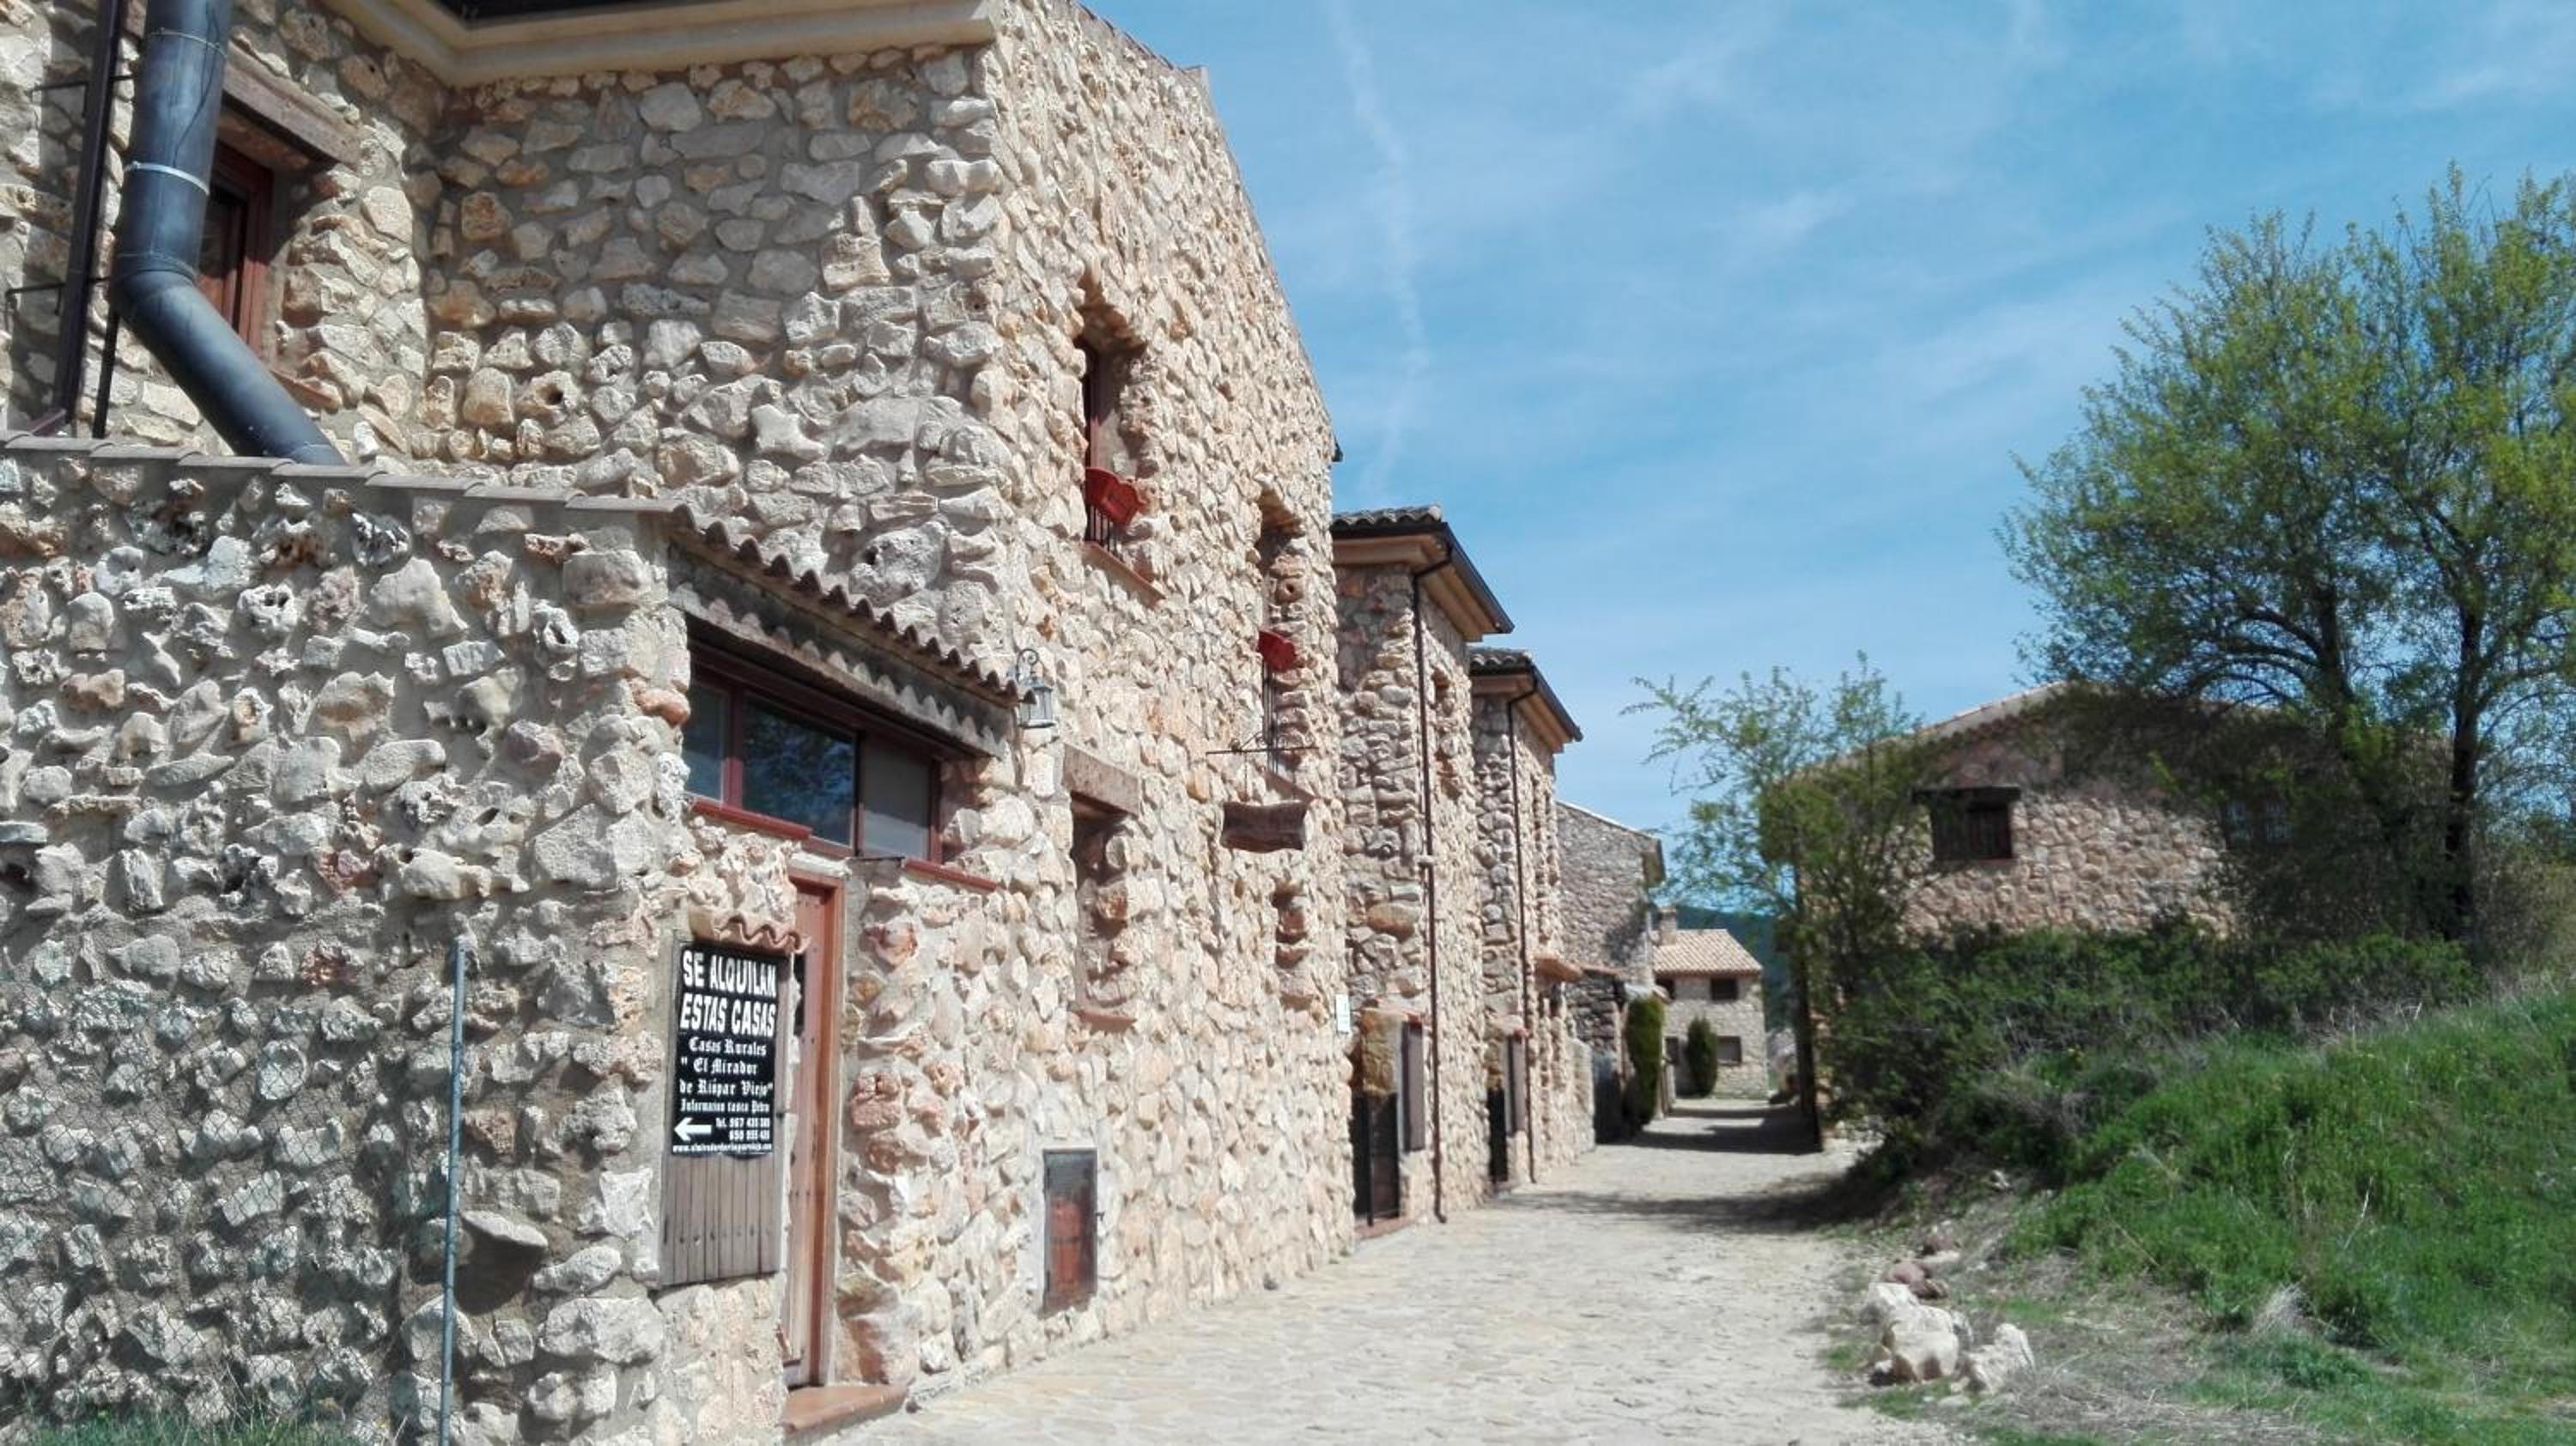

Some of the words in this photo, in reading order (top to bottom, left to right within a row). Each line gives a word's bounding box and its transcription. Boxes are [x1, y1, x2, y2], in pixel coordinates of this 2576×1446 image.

[683, 950, 704, 987] SE
[710, 954, 776, 999] ALQUILAN
[680, 992, 727, 1033] ESTAS
[732, 999, 776, 1038] CASAS
[689, 1036, 721, 1054] Casas
[724, 1038, 766, 1056] Rurales
[693, 1057, 708, 1072] El
[711, 1058, 756, 1074] Mirador
[679, 1078, 693, 1094] de
